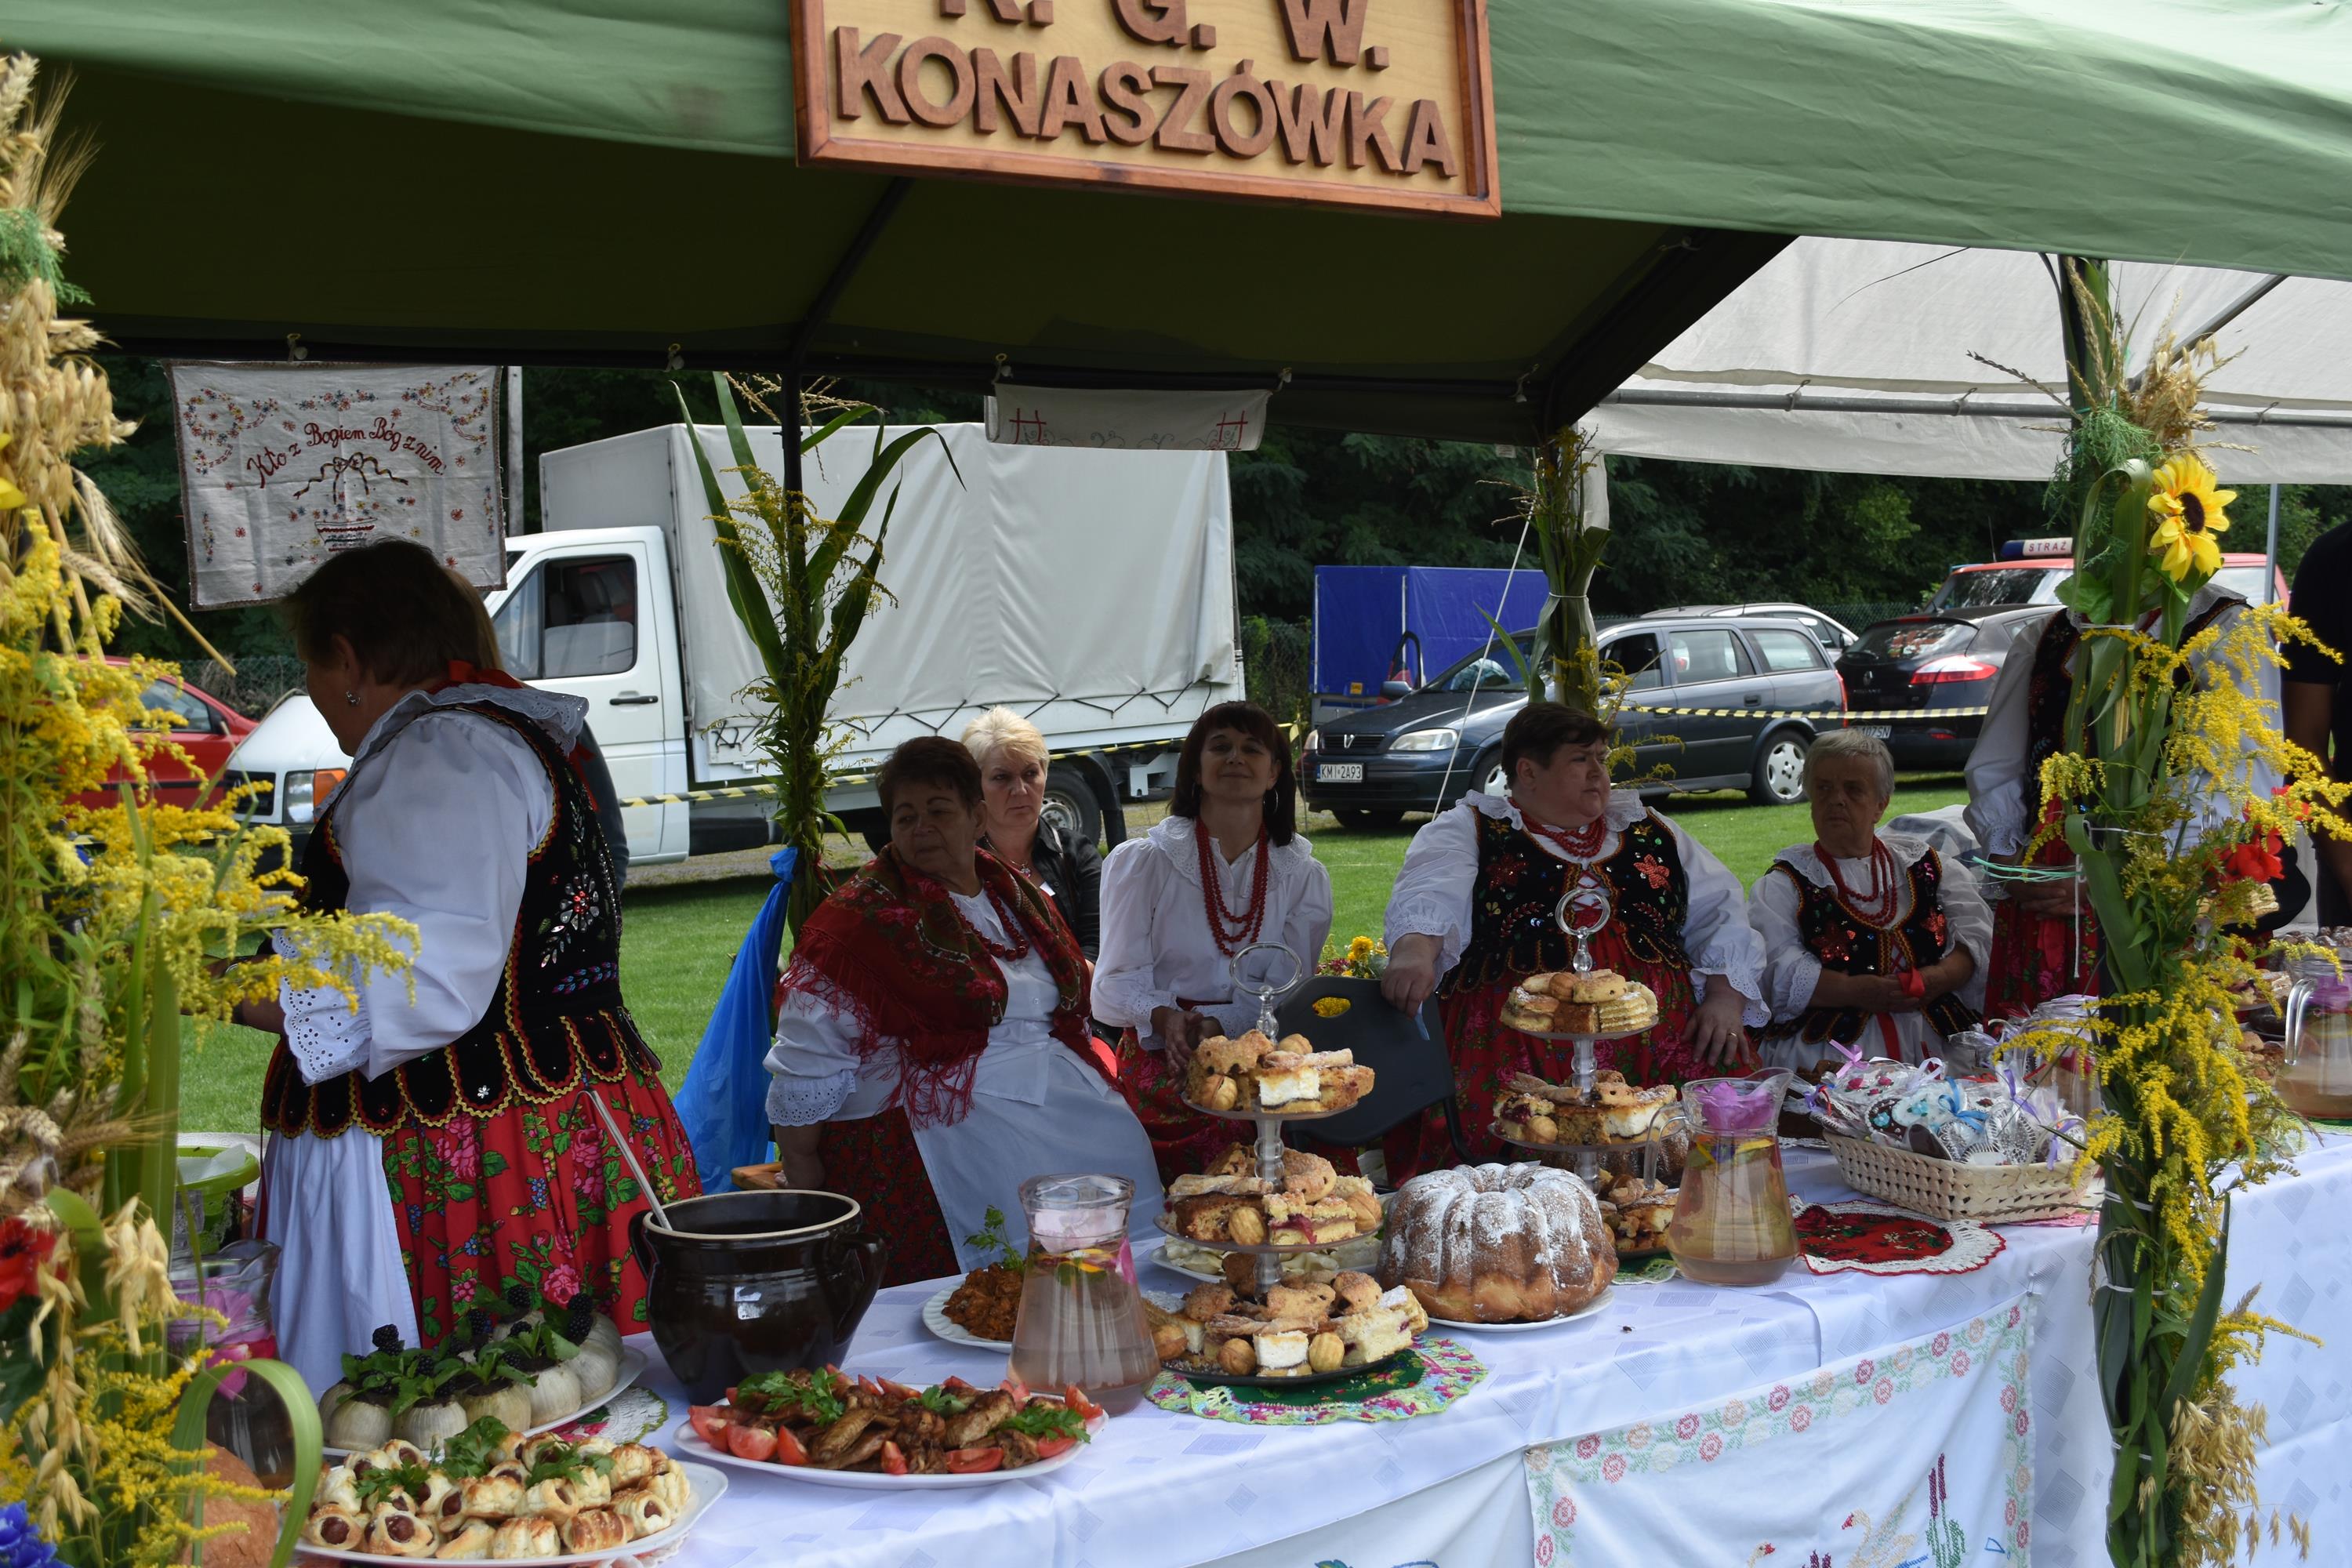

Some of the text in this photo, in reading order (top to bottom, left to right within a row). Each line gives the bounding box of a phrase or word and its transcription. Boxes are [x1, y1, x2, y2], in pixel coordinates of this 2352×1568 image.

[1275, 0, 1390, 71] W.
[834, 25, 1458, 178] KONASZÓWKA
[247, 447, 288, 488] Kto
[289, 443, 302, 457] z
[304, 422, 366, 448] Bogiem
[368, 416, 401, 452] Bóg
[403, 436, 416, 451] z
[2028, 541, 2067, 553] STRAŻ
